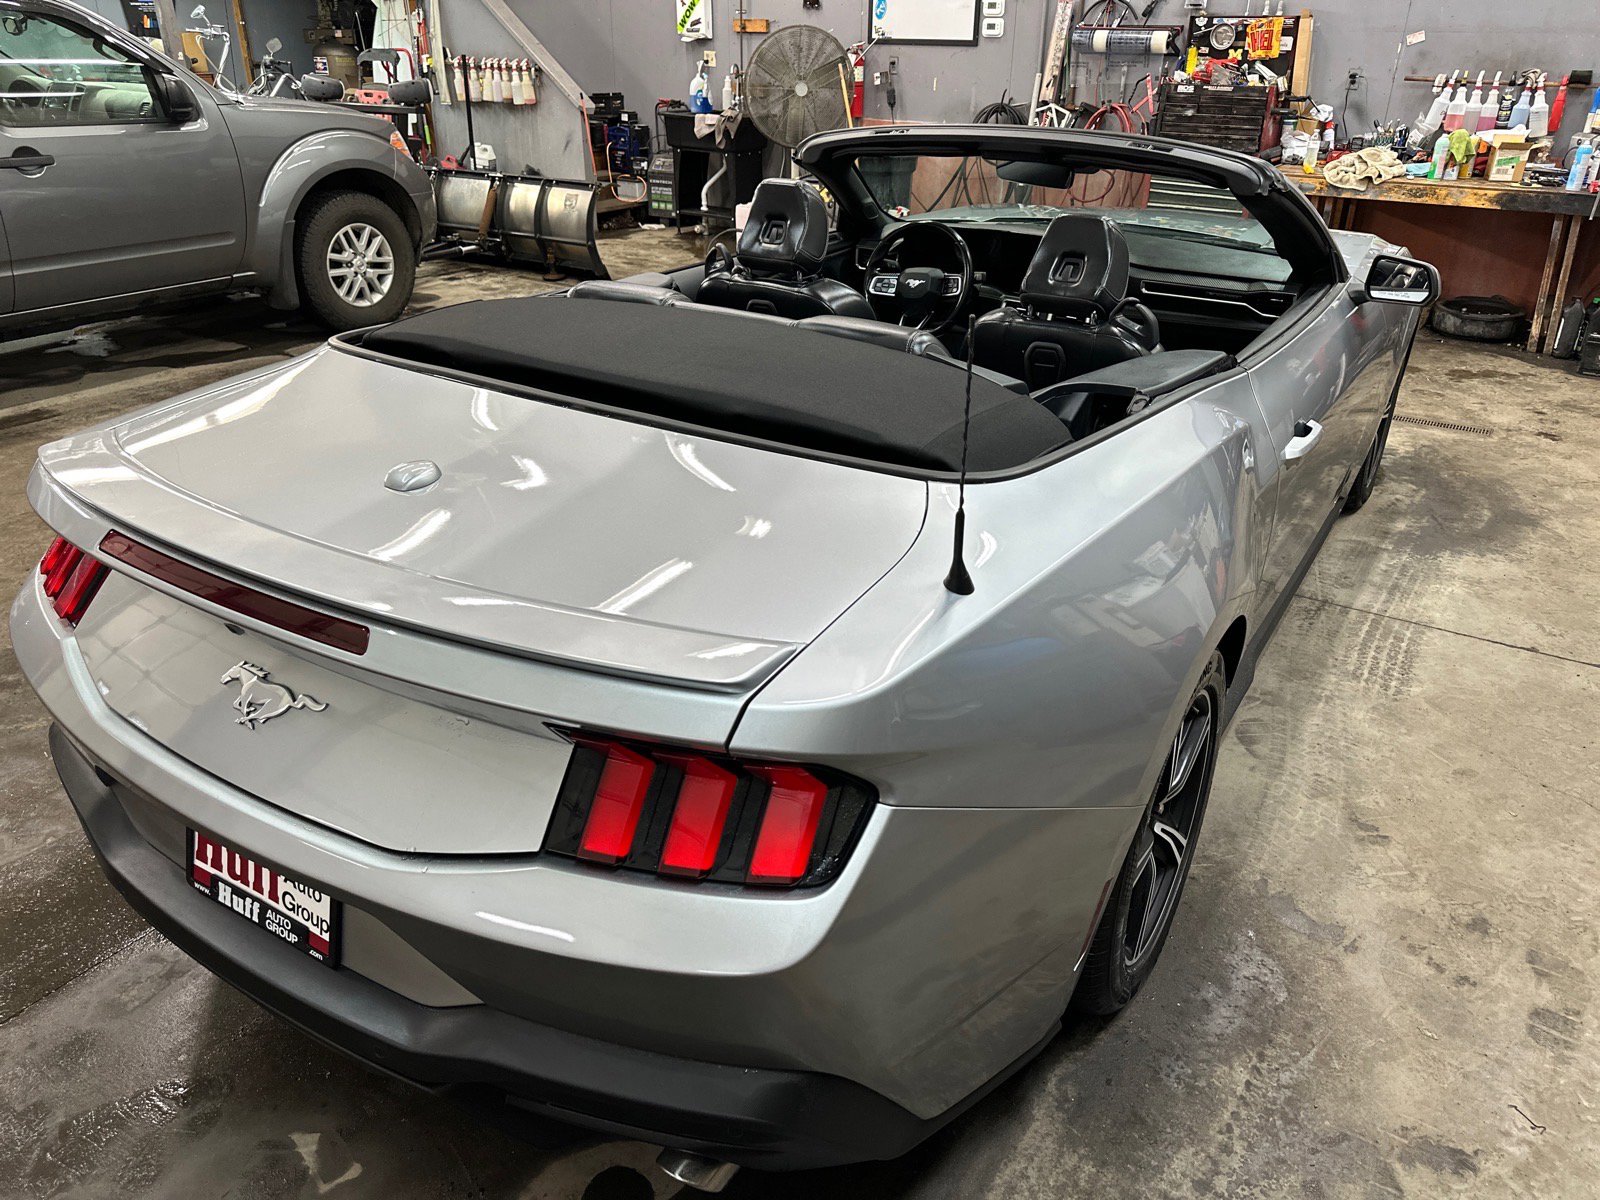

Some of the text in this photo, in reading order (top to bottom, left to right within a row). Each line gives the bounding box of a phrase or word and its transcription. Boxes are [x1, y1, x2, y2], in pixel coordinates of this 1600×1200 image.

[194, 882, 211, 896] www.
[218, 881, 260, 923] Huff
[282, 891, 330, 936] Group
[266, 909, 292, 930] AUTO
[266, 919, 298, 944] GROUP
